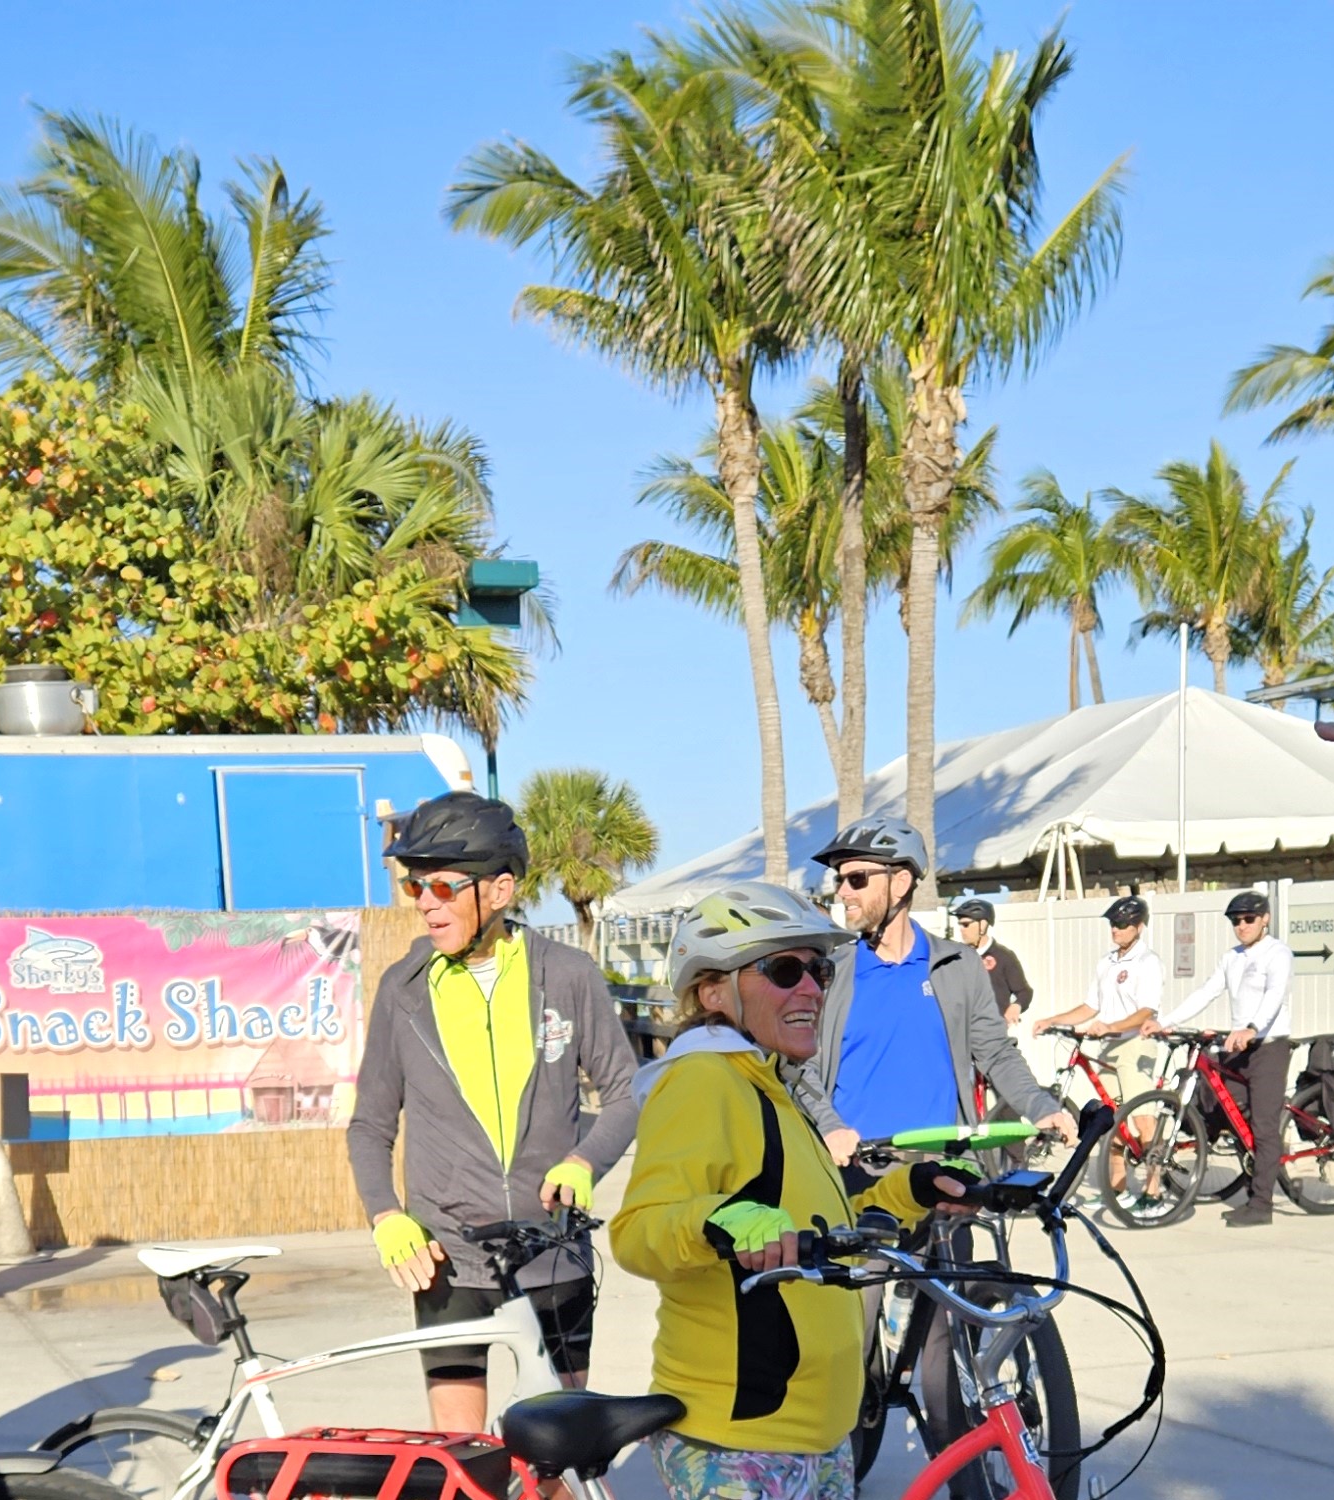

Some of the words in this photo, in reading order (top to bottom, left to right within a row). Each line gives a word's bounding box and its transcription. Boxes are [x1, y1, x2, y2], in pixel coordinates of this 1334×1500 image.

[1290, 919, 1334, 934] DELIVERIES
[12, 962, 101, 988] Sharky's
[166, 977, 339, 1044] Shack
